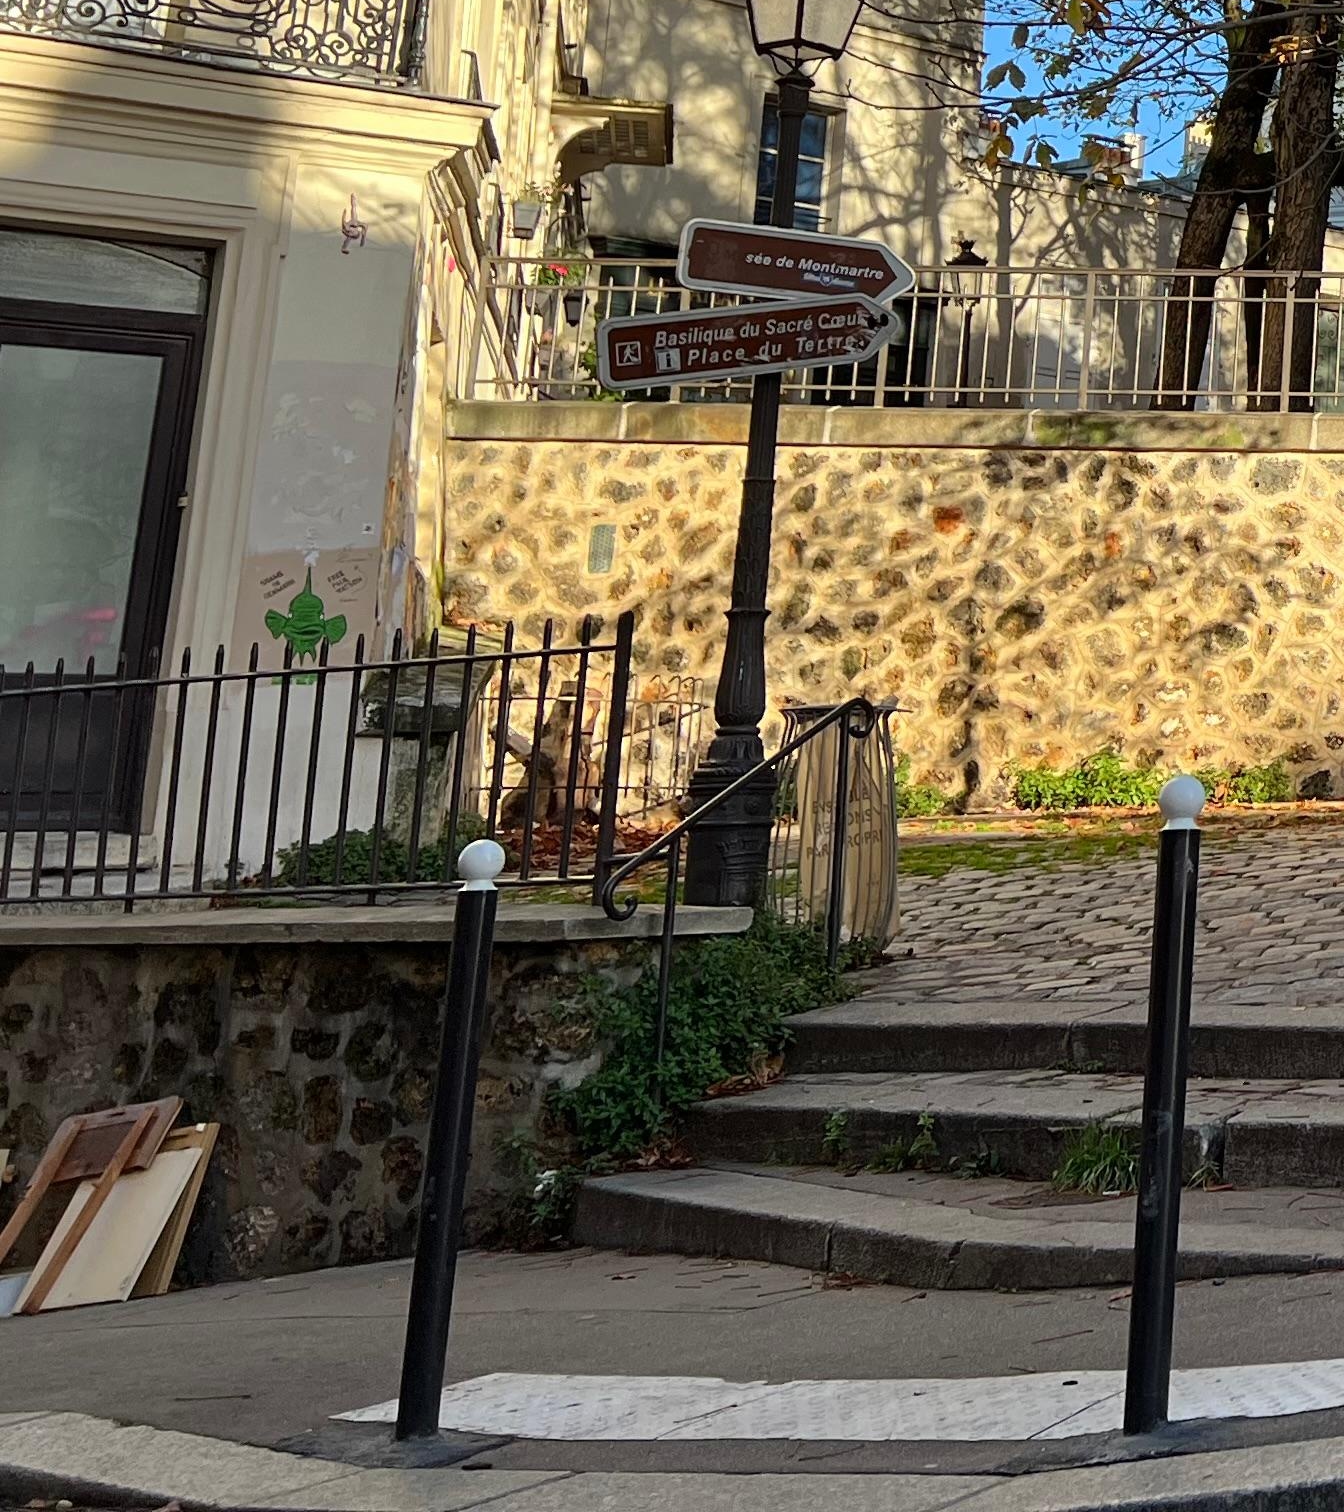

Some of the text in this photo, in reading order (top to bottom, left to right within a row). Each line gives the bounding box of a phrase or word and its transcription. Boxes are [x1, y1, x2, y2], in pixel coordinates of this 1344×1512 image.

[776, 255, 794, 269] de
[798, 257, 885, 280] Montmartre
[655, 326, 735, 348] Basilique
[740, 321, 760, 338] du
[764, 314, 813, 335] Sacré
[687, 347, 745, 366] Place
[758, 340, 782, 358] du
